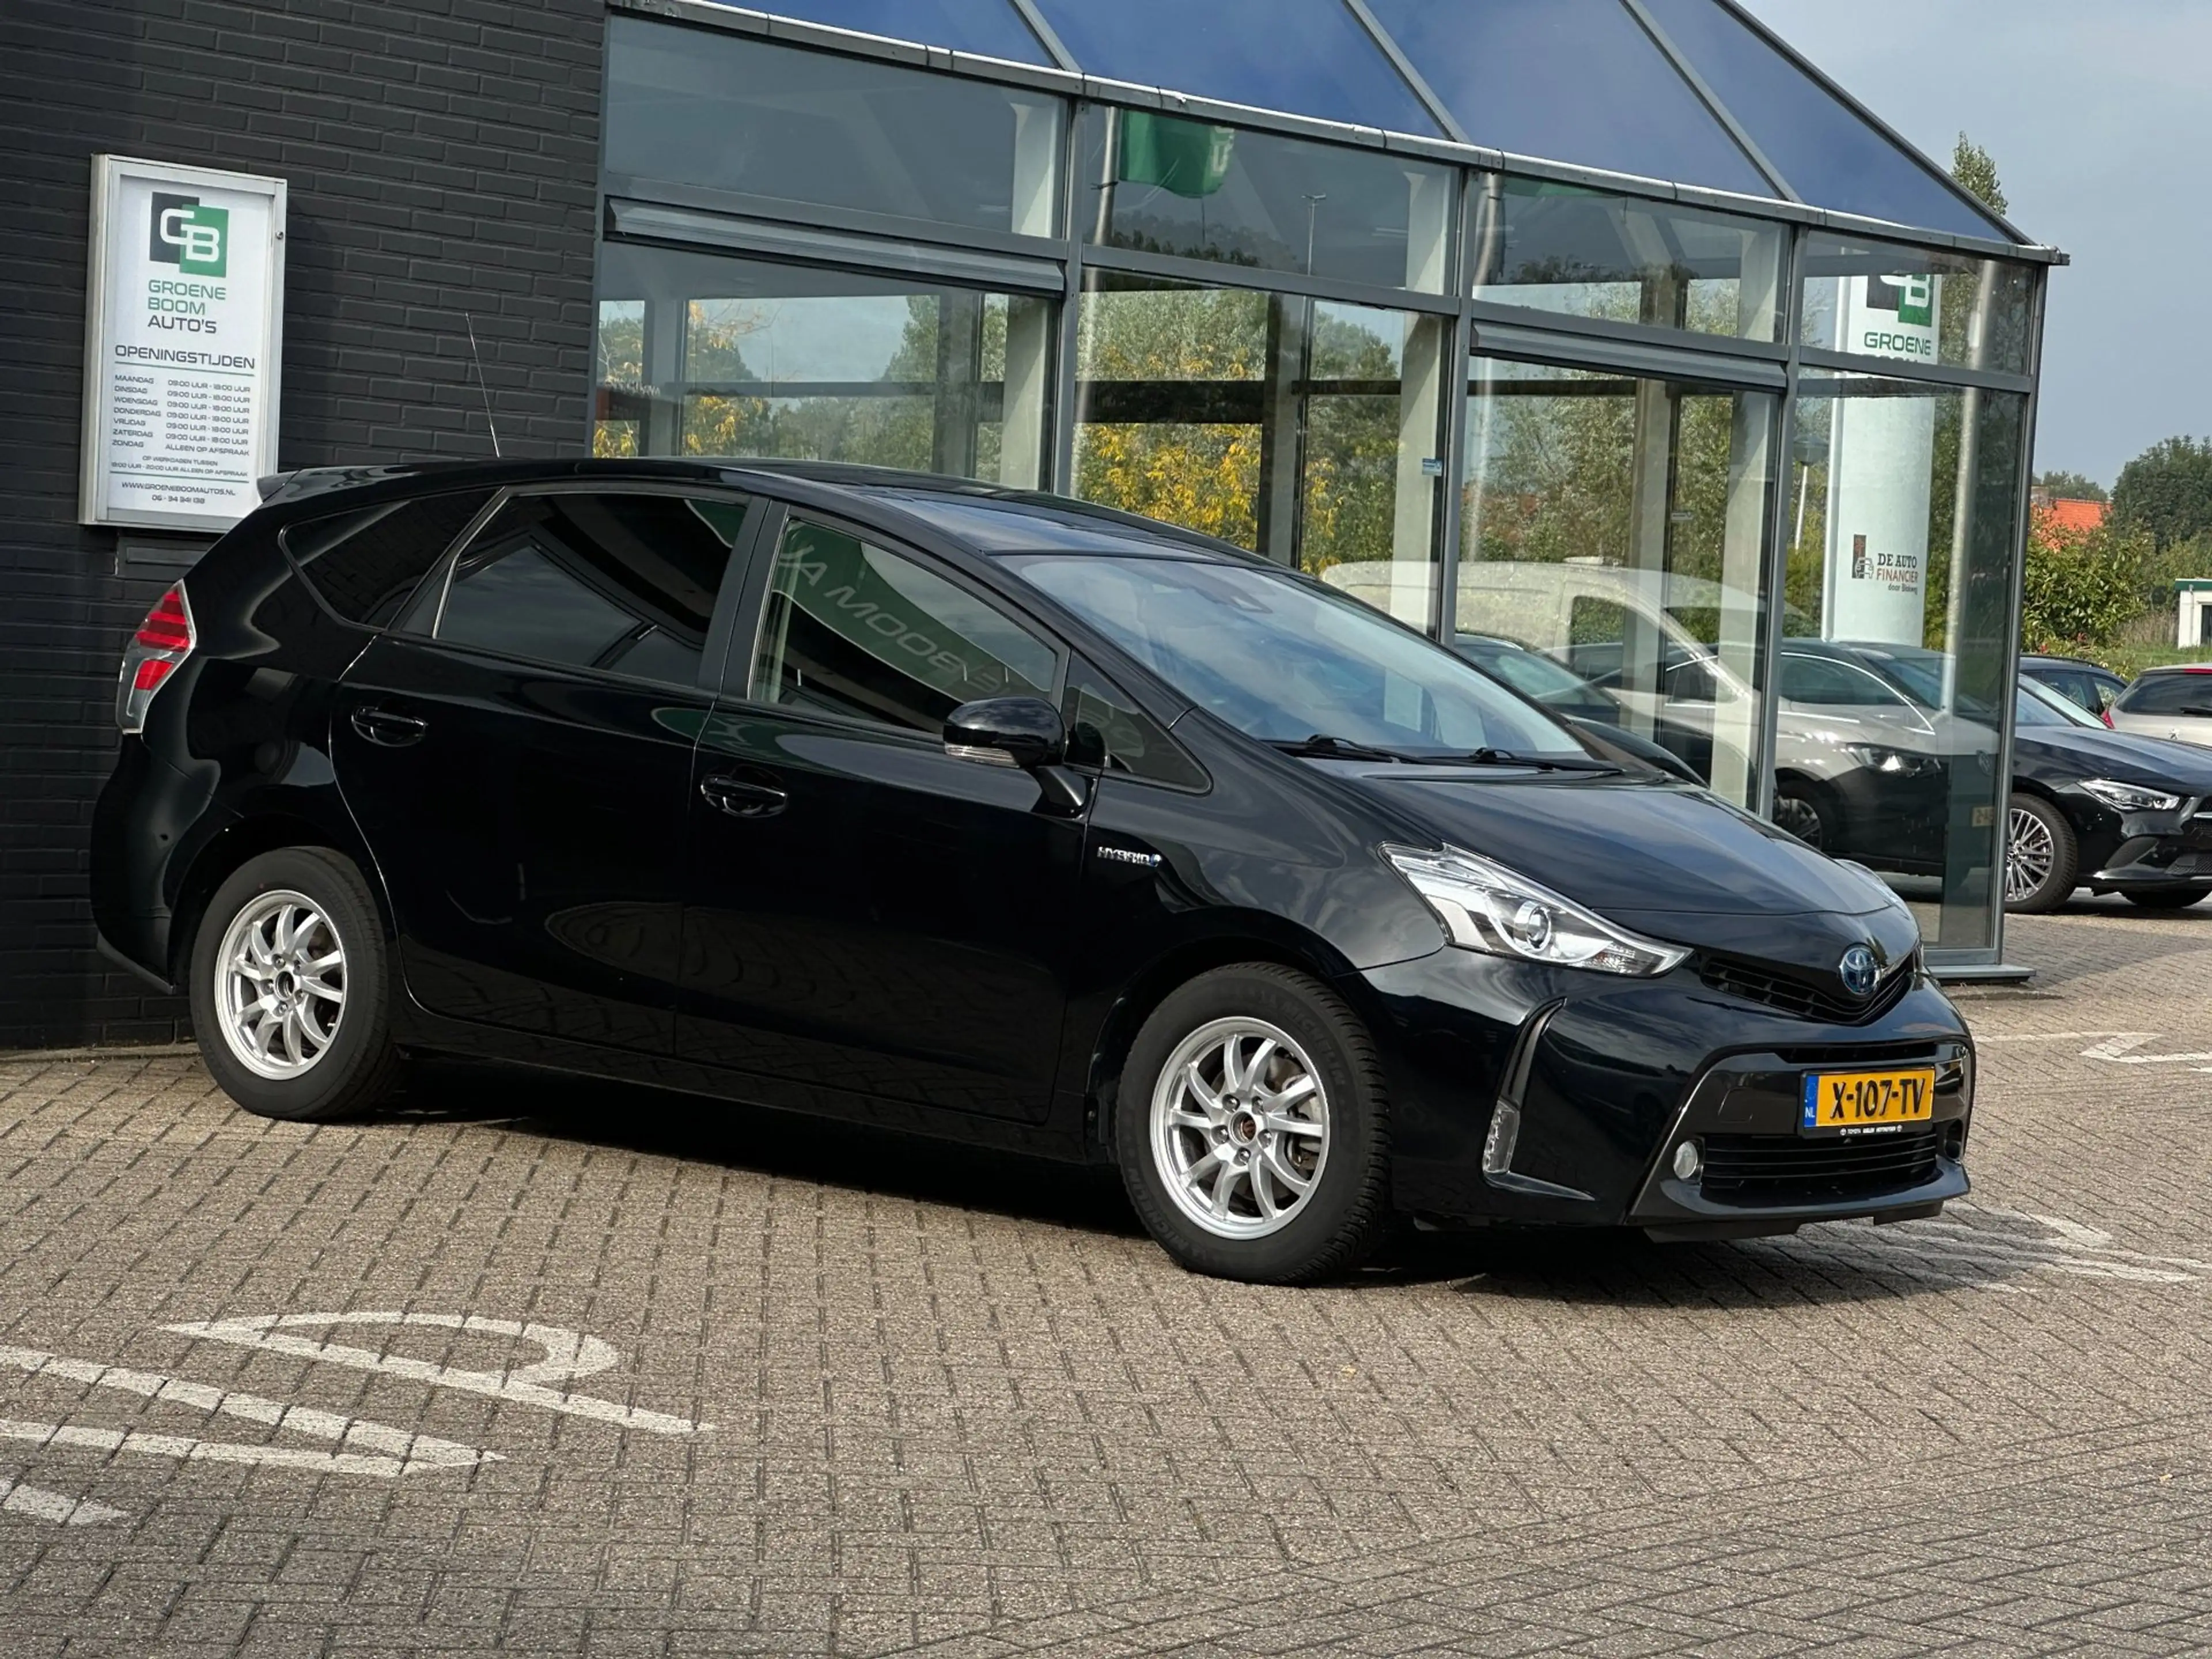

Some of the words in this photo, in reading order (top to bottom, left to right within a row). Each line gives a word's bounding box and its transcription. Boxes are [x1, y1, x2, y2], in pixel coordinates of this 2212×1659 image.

[148, 280, 226, 300] GROENE
[147, 297, 205, 315] BOOM
[147, 315, 217, 334] AUTO'S
[1864, 331, 1931, 356] GROENE
[115, 344, 255, 369] OPENINGSTIJDEN
[112, 438, 144, 448] ZONDAG
[1877, 553, 1893, 566] DE
[1895, 554, 1917, 569] AUTO
[1876, 567, 1919, 583] FINANCIER
[1097, 846, 1150, 865] HYBRID
[1805, 1107, 1815, 1118] NL
[1830, 1078, 1925, 1120] X-107-TV
